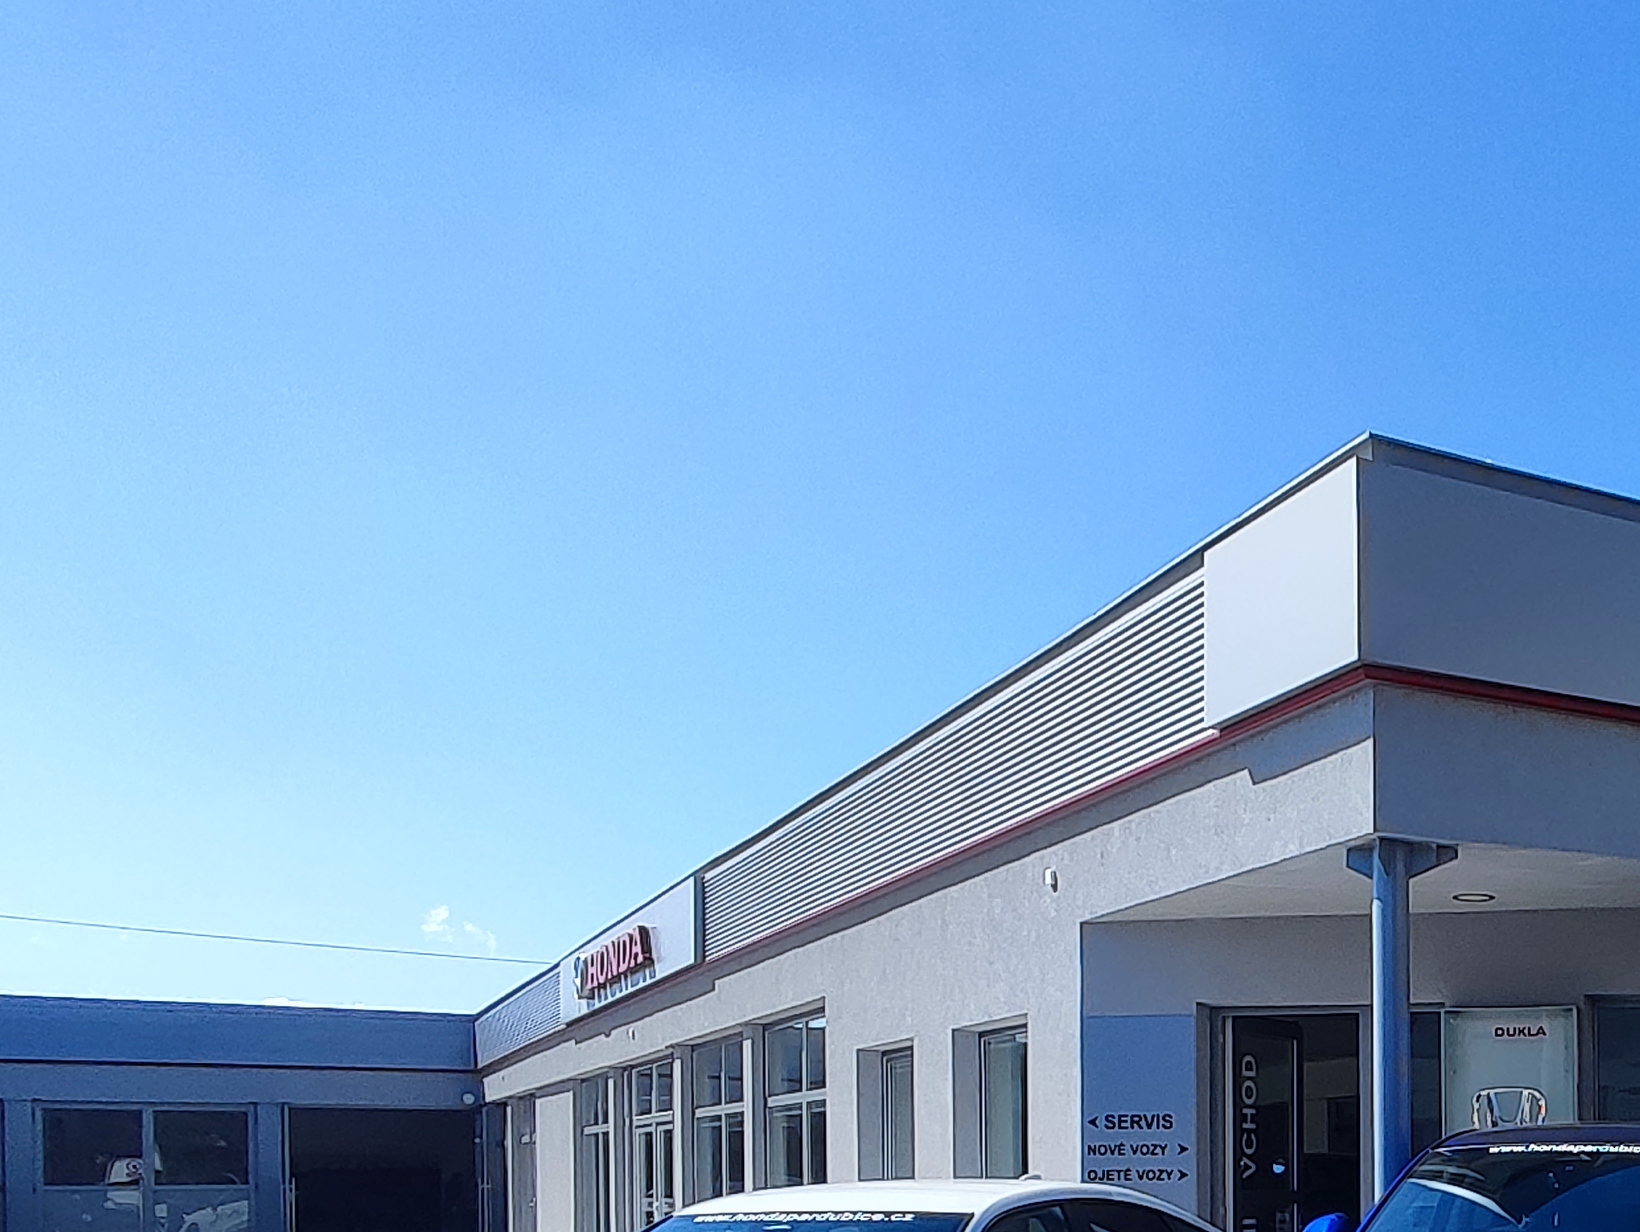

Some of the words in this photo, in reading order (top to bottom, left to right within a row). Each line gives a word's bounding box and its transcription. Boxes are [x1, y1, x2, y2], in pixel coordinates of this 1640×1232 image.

[586, 926, 651, 990] HONDA
[1494, 1026, 1547, 1037] DUKLA
[1104, 1113, 1174, 1130] SERVIS
[1241, 1055, 1257, 1179] VCHOD
[1087, 1141, 1126, 1156] NOVÉ
[1130, 1143, 1168, 1156] VOZY
[1087, 1167, 1133, 1181] OJETÉ
[1136, 1169, 1175, 1182] VOZY
